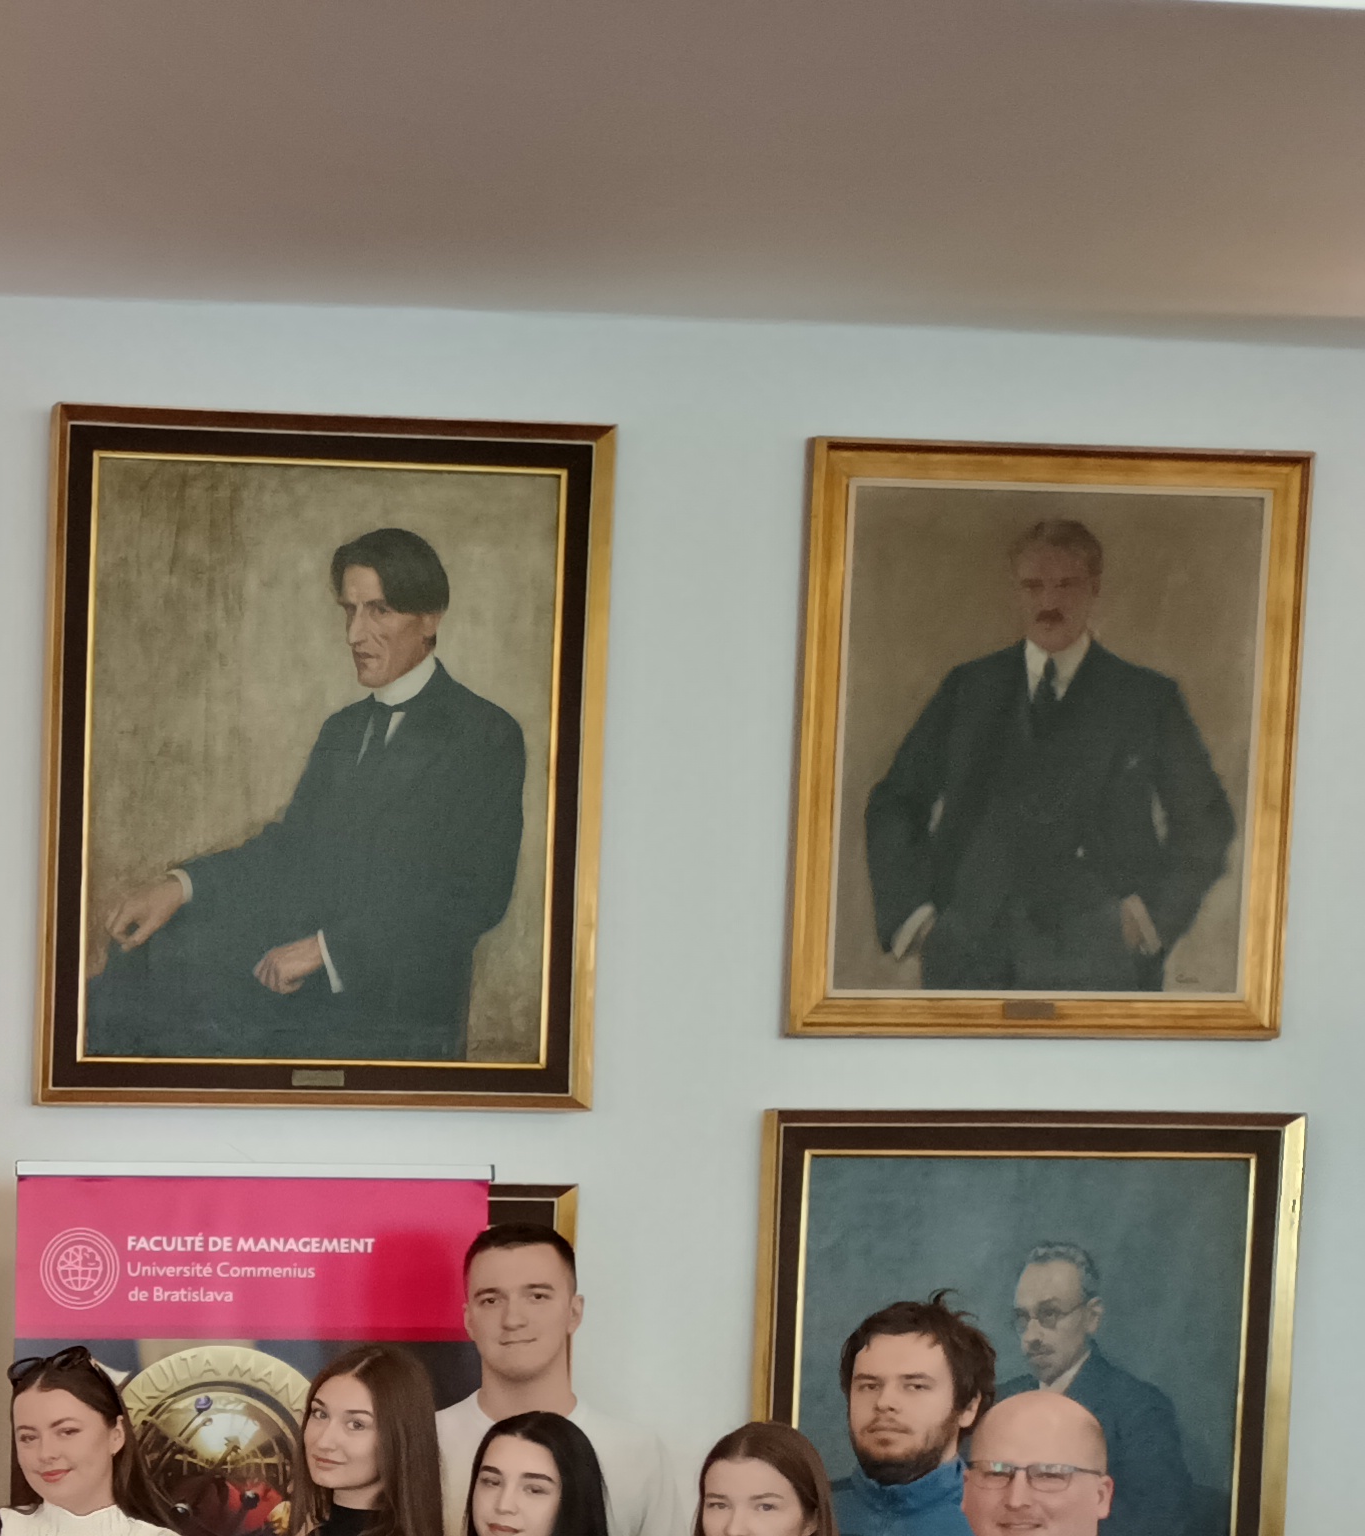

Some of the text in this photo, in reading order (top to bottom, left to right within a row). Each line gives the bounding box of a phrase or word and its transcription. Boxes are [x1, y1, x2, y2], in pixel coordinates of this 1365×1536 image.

[127, 1232, 375, 1254] FACULTÉ DE MANAGEMENT
[127, 1261, 316, 1279] Université Commenius
[128, 1286, 233, 1303] de Bratislava
